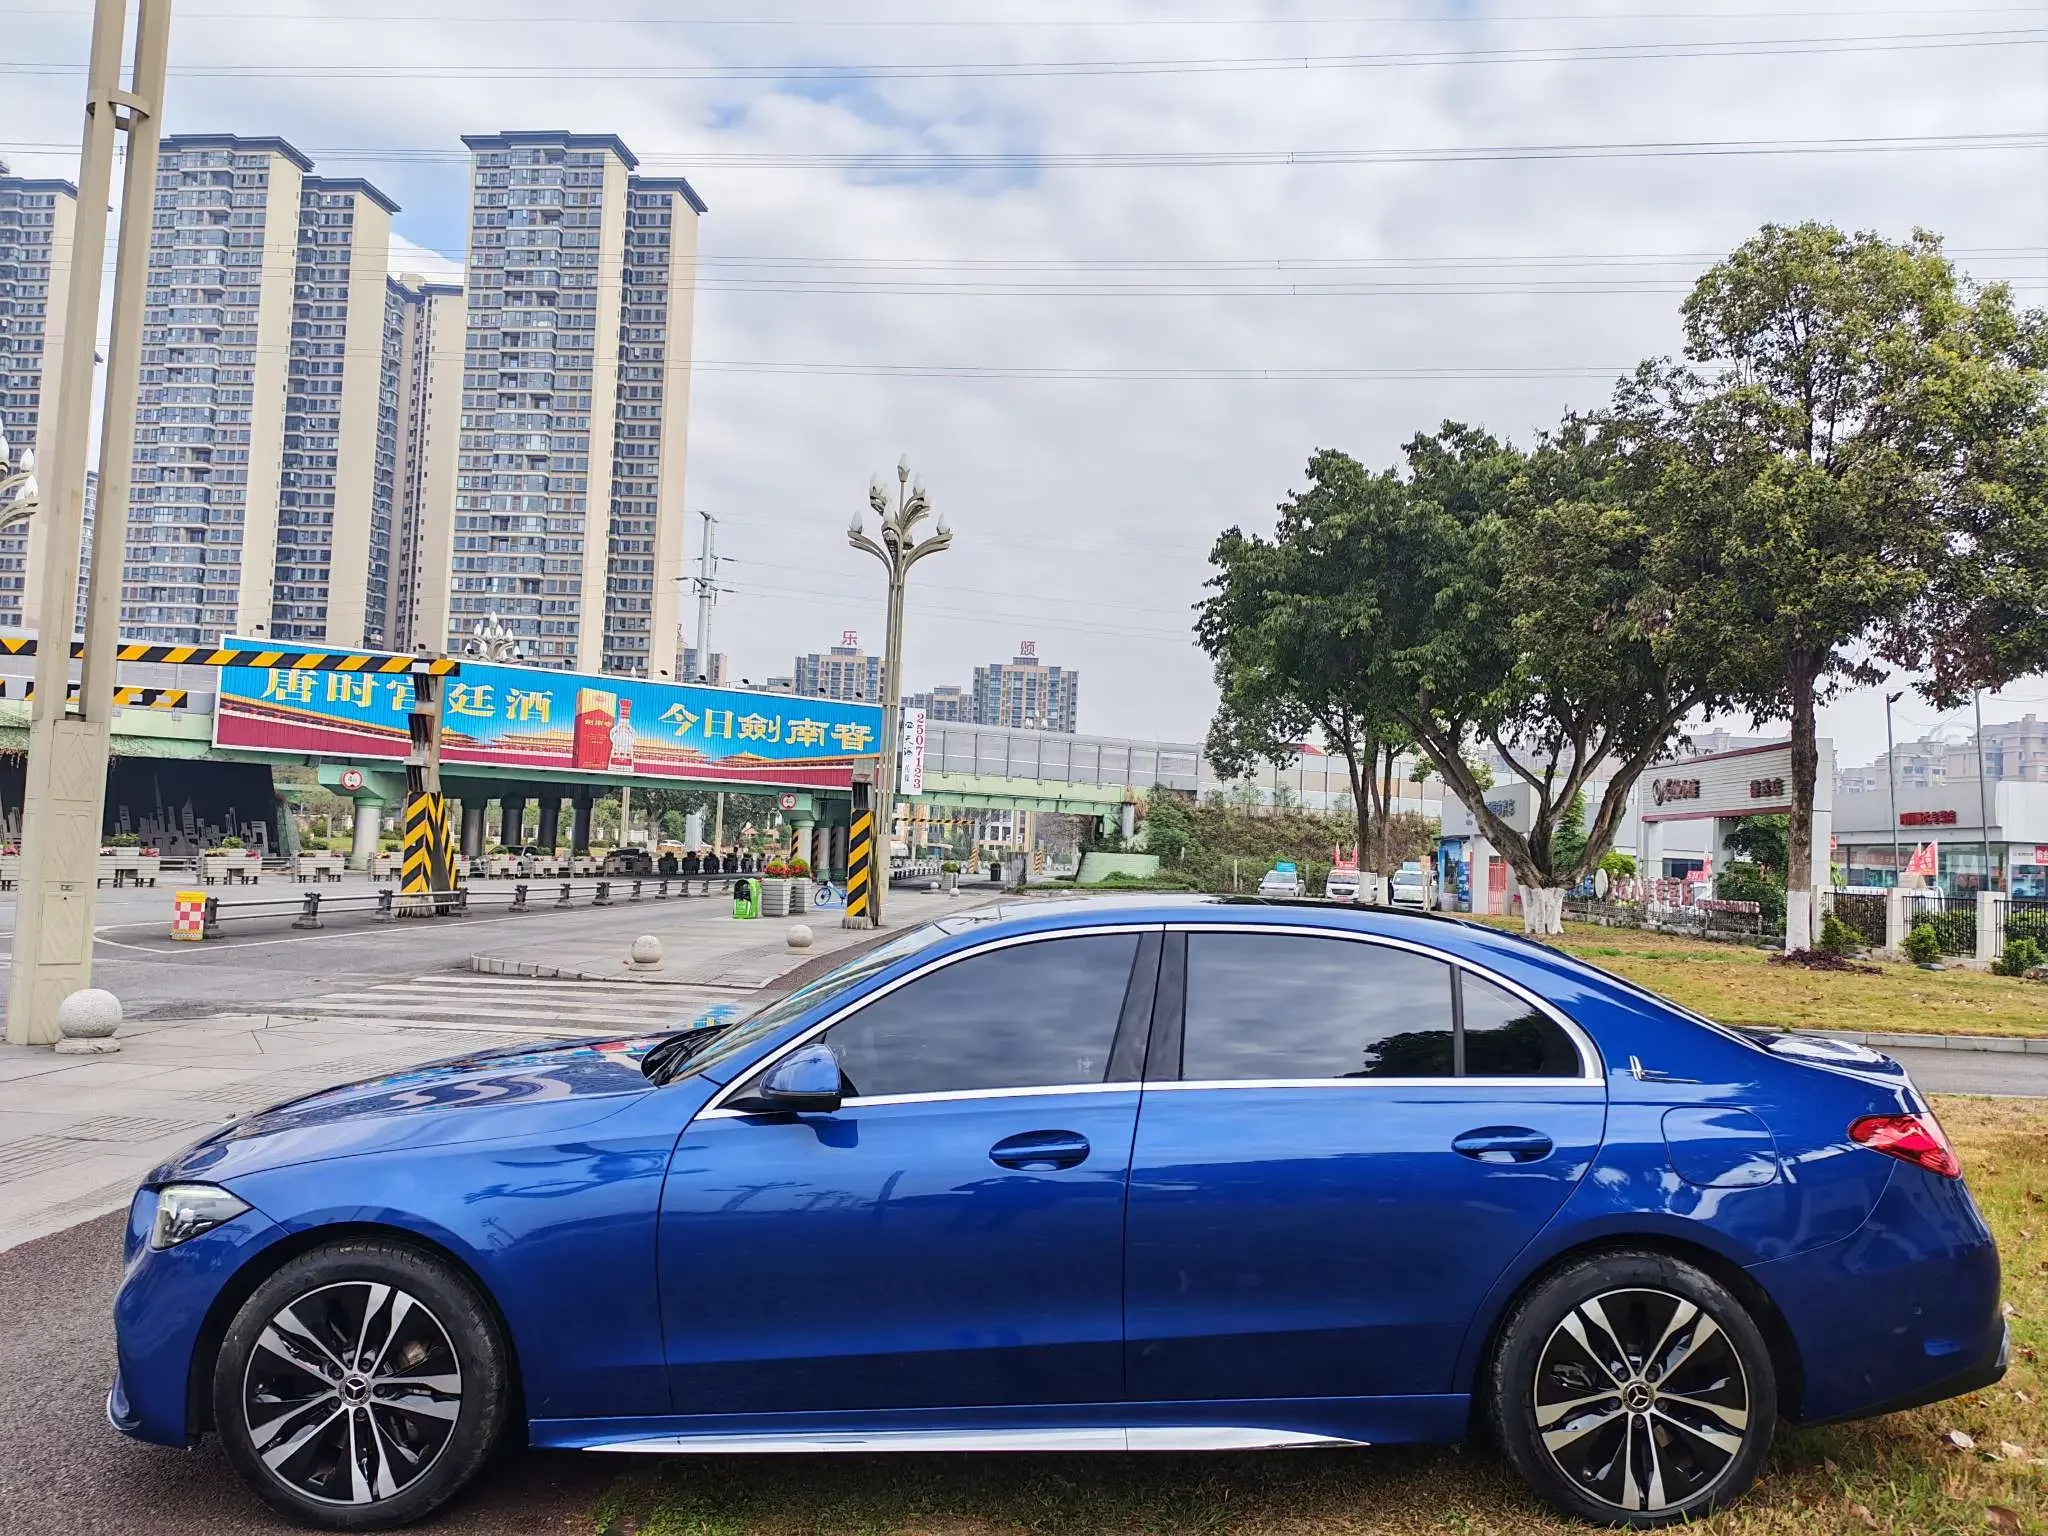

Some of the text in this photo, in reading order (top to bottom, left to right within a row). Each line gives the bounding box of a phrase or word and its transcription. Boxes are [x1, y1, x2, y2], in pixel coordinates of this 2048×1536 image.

[841, 630, 858, 645] 乐
[1020, 640, 1036, 656] 颂
[913, 712, 925, 789] 2507123
